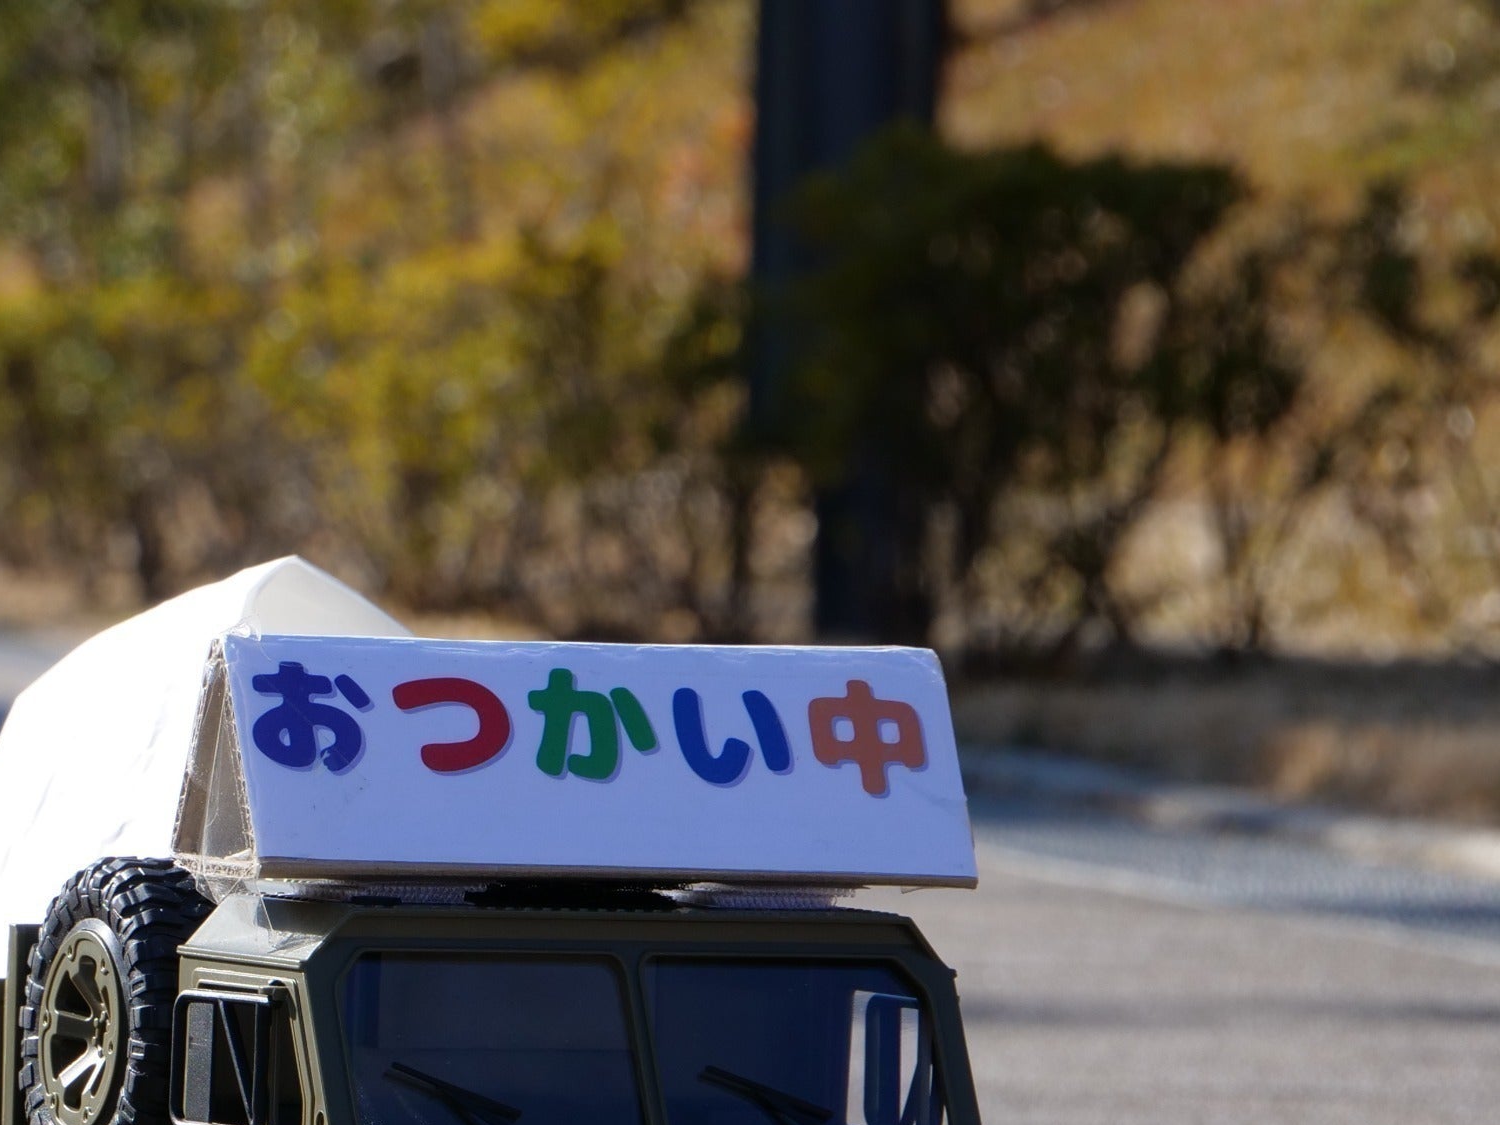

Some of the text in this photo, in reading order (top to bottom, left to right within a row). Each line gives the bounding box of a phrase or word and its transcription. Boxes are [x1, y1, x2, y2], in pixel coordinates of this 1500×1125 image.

[251, 660, 930, 798] おつかい中
